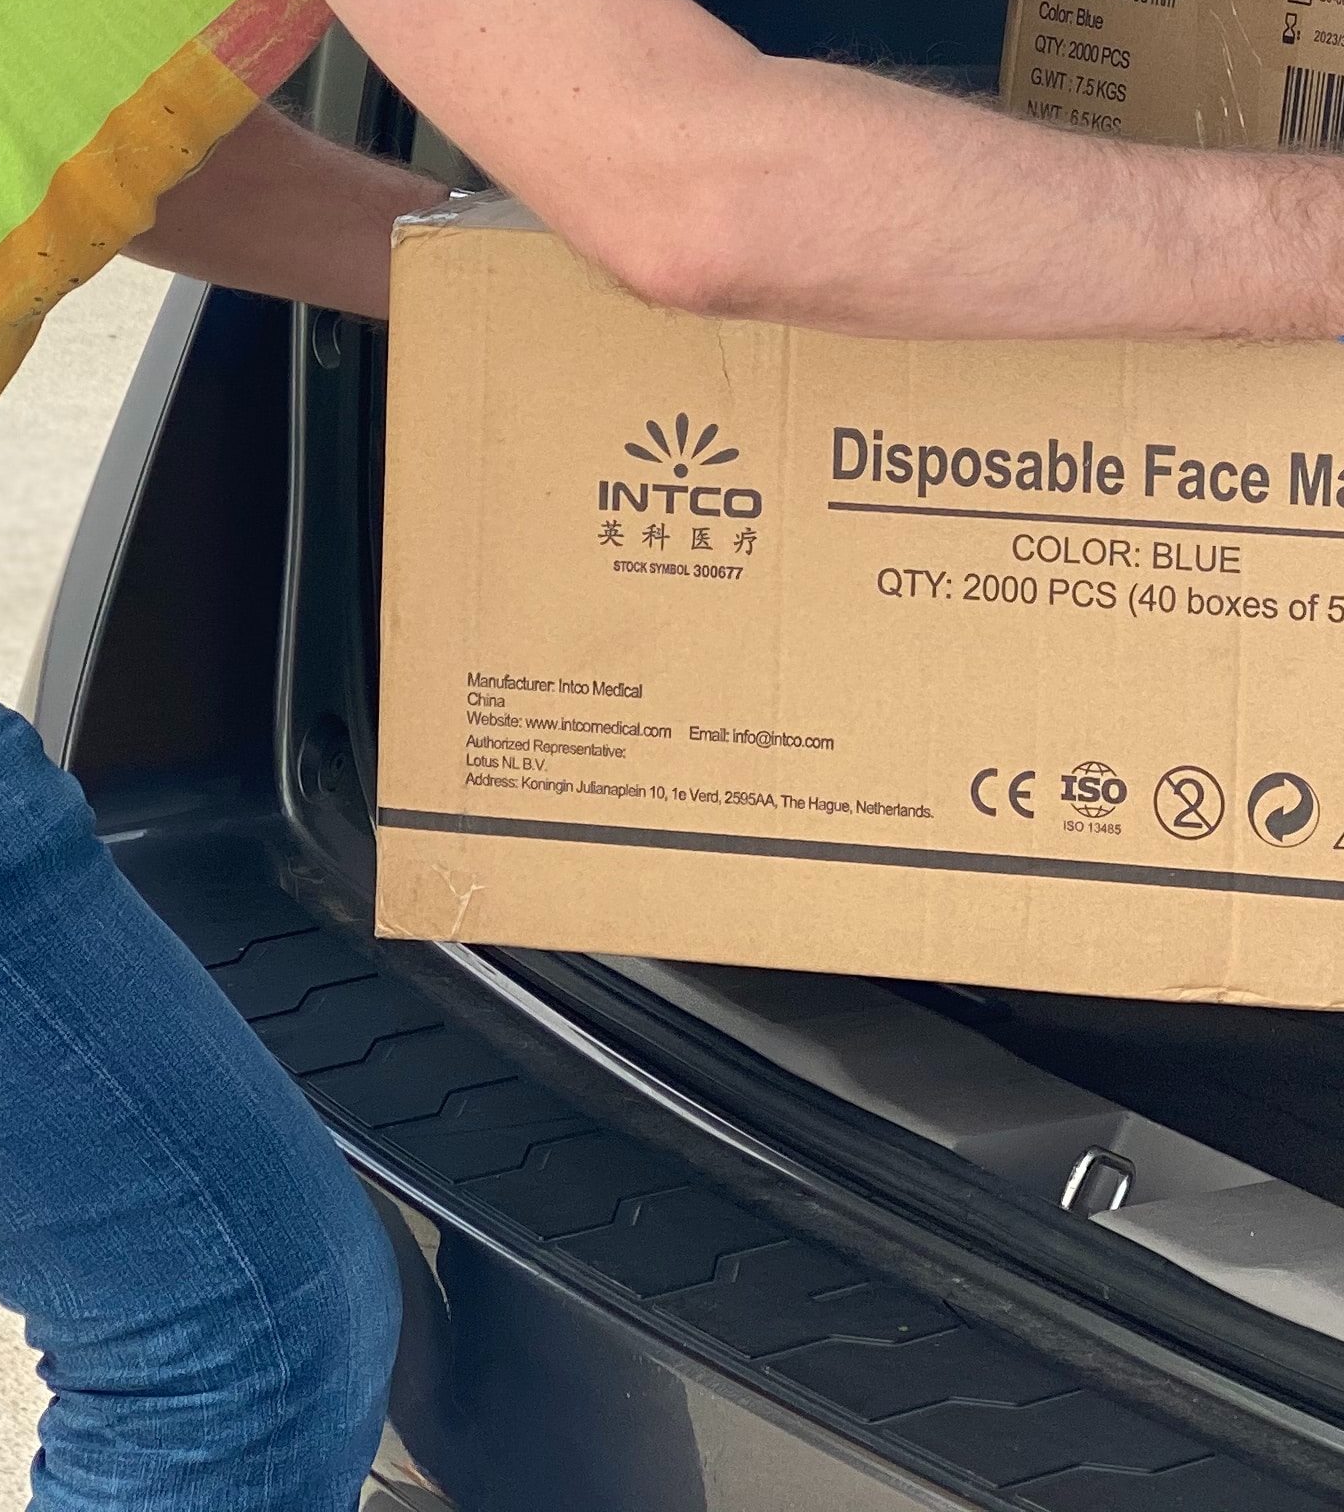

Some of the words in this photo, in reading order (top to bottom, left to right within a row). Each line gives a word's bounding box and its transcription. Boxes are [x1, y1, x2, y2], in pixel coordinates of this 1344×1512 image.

[1038, 0, 1074, 25] Color:
[1075, 7, 1104, 30] Blue
[832, 426, 1125, 498] Disposable
[1144, 443, 1270, 504] Face
[598, 479, 762, 519] INTCO
[597, 518, 758, 556] 英科医疗
[1011, 533, 1140, 568] COLOR:
[1152, 541, 1241, 574] BLUE
[612, 559, 648, 573] STOCK
[649, 562, 690, 576] SYMBOL
[693, 563, 744, 580] 300677
[876, 567, 952, 599] QTY:
[961, 572, 1038, 604] 2000
[1048, 577, 1117, 609] PCS
[1128, 582, 1176, 618] (40
[1187, 585, 1278, 619] boxes
[1288, 593, 1320, 622] of
[466, 691, 505, 708] China
[467, 671, 555, 692] Manufacturer:
[558, 677, 590, 695] Intco
[592, 679, 643, 699] Medical
[465, 710, 522, 728] Website:
[524, 716, 672, 739] www.intcomedical.com
[688, 725, 730, 742] Email:
[732, 728, 834, 751] info@intco.com
[465, 733, 530, 752] Authorized
[532, 738, 626, 759] Representative:
[465, 752, 500, 769] Lotus
[501, 754, 520, 770] NL
[522, 756, 547, 772] B.V.
[464, 771, 518, 788] Address:
[649, 785, 668, 802] 10,
[688, 787, 721, 805] Verd,
[723, 790, 778, 809] 2595AA,
[779, 794, 805, 810] The
[807, 795, 853, 815] Hague,
[855, 799, 934, 819] Netherlands.
[1062, 819, 1085, 833] ISO
[1087, 821, 1122, 836] 13485
